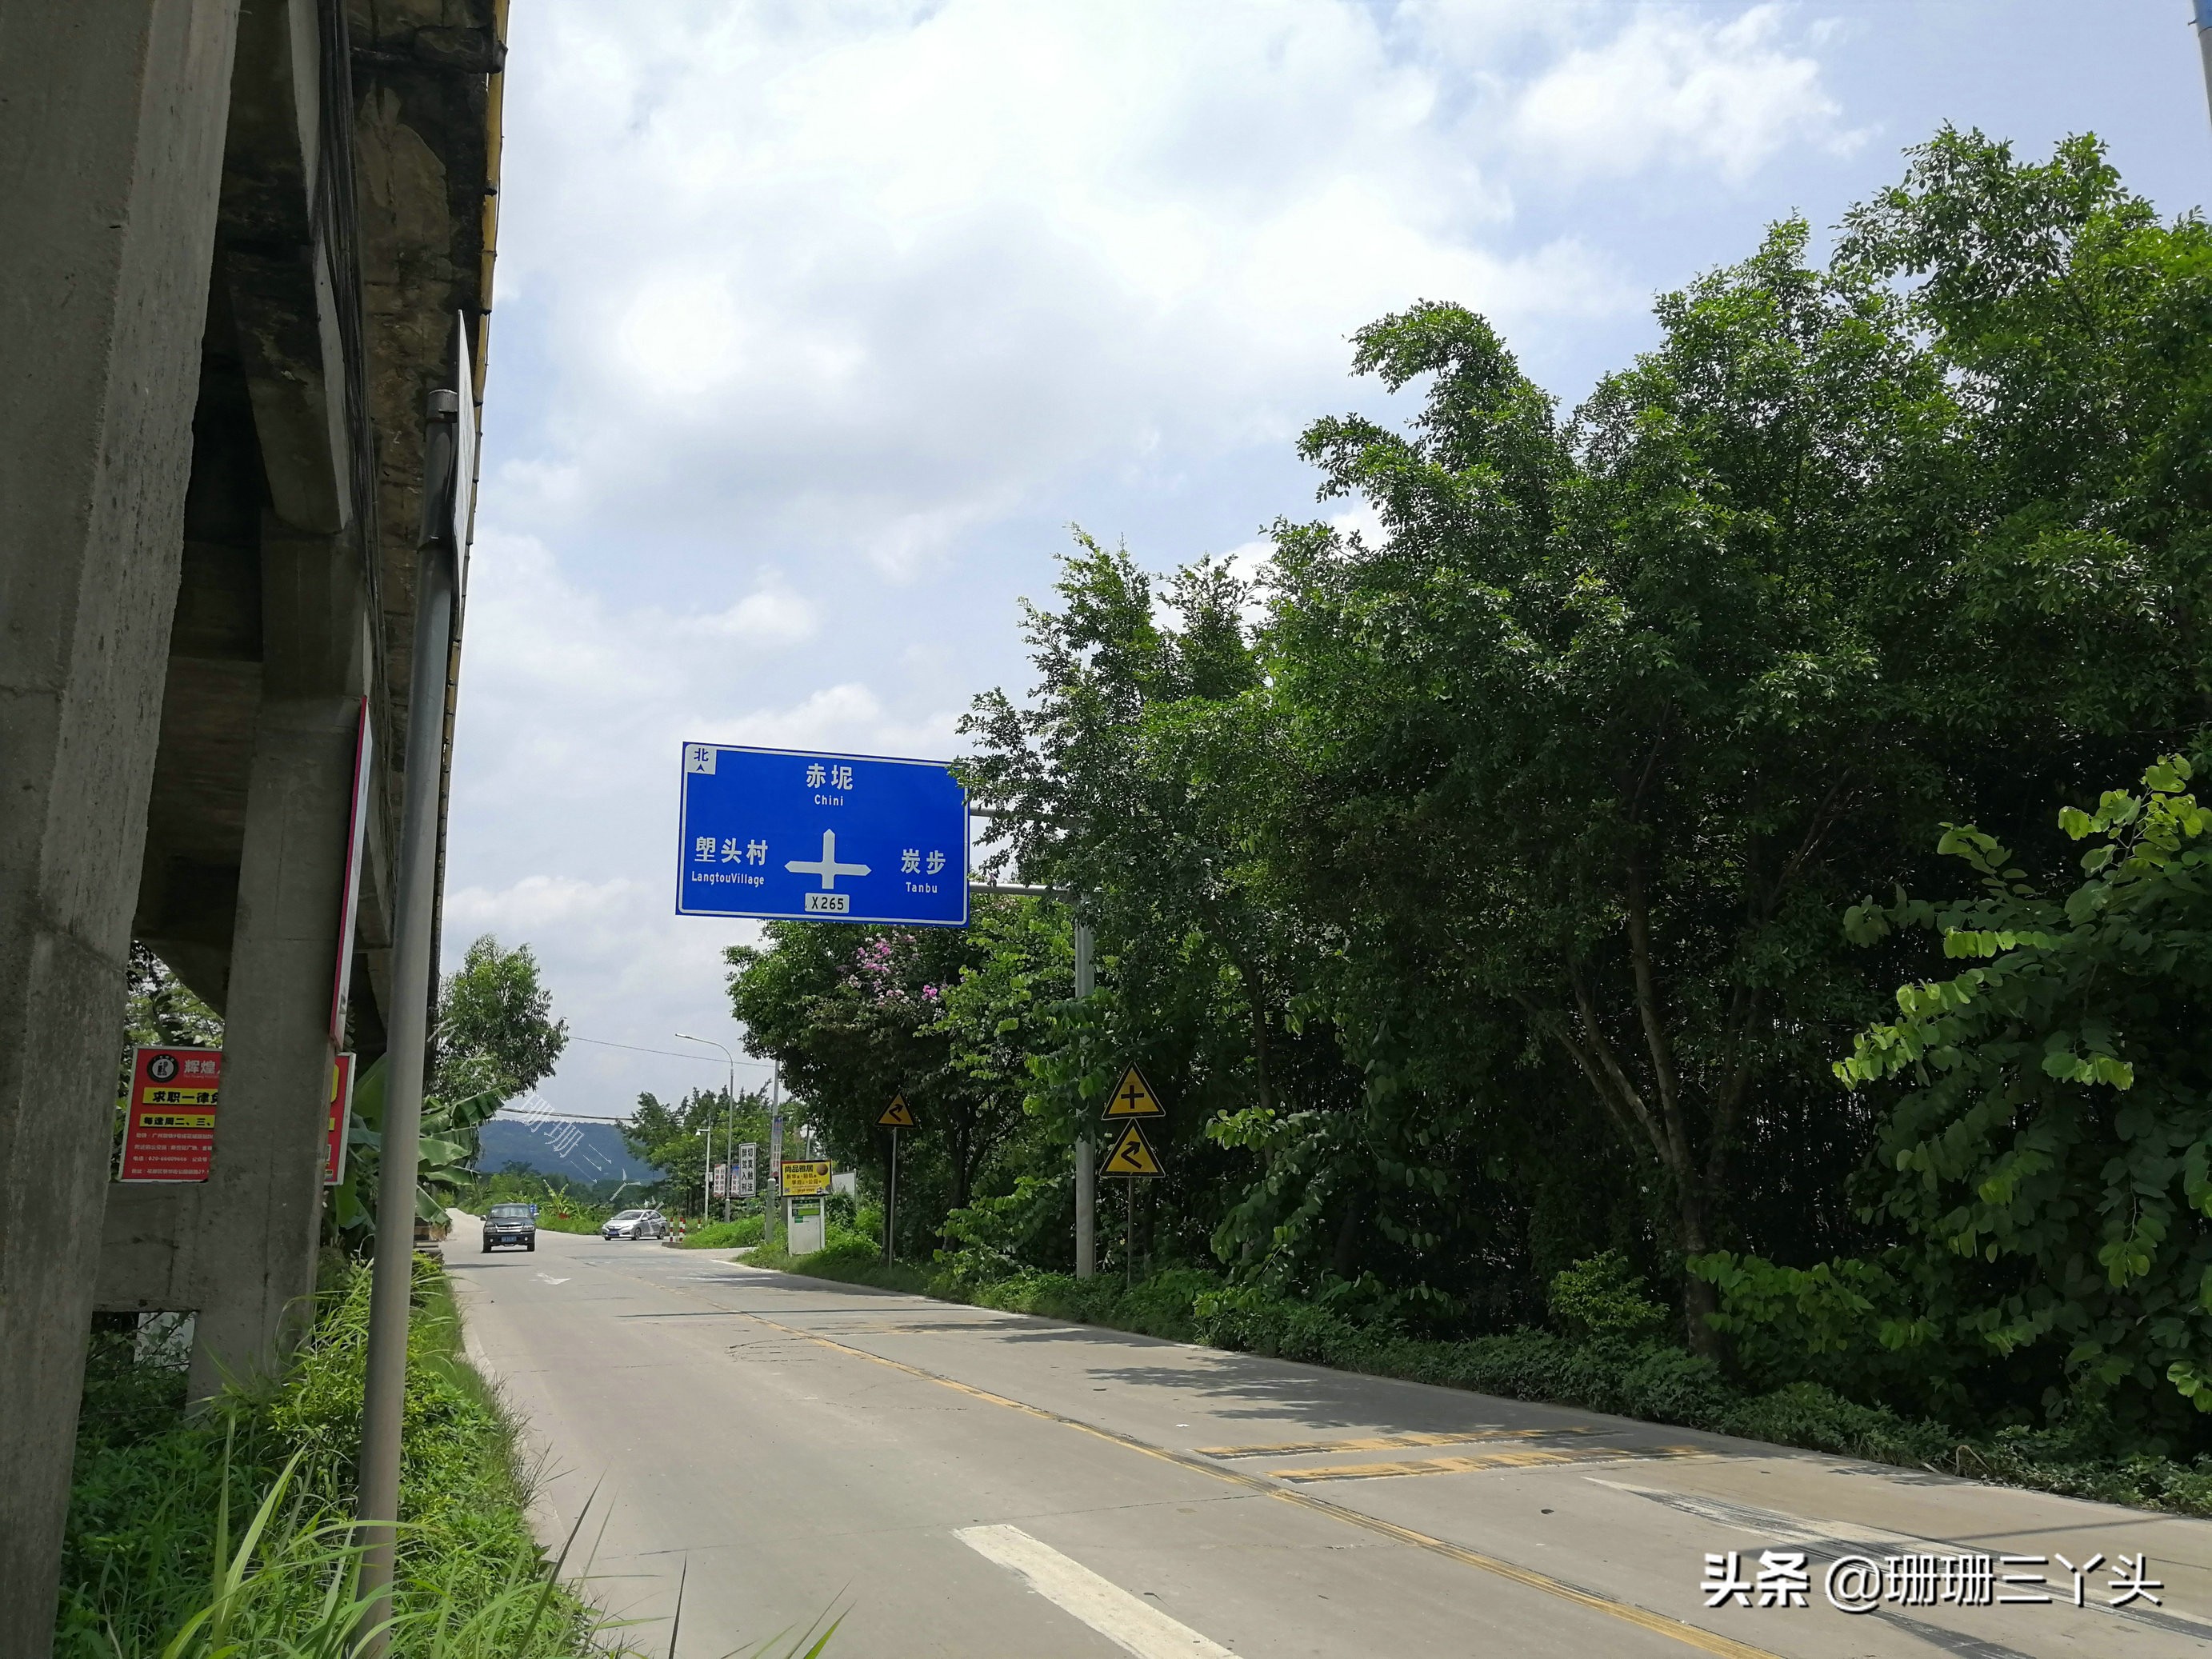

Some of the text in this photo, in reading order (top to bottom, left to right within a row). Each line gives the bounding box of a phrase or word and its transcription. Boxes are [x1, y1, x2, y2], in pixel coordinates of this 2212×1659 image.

[694, 747, 710, 762] 北
[806, 763, 854, 790] 赤坭
[814, 794, 844, 807] Chini
[694, 836, 769, 865] 塱头村
[901, 848, 946, 875] 炭步
[691, 870, 765, 888] LangtouVillage
[905, 881, 938, 893] Tanbu
[810, 895, 845, 911] X265
[184, 1059, 220, 1074] 辉煌
